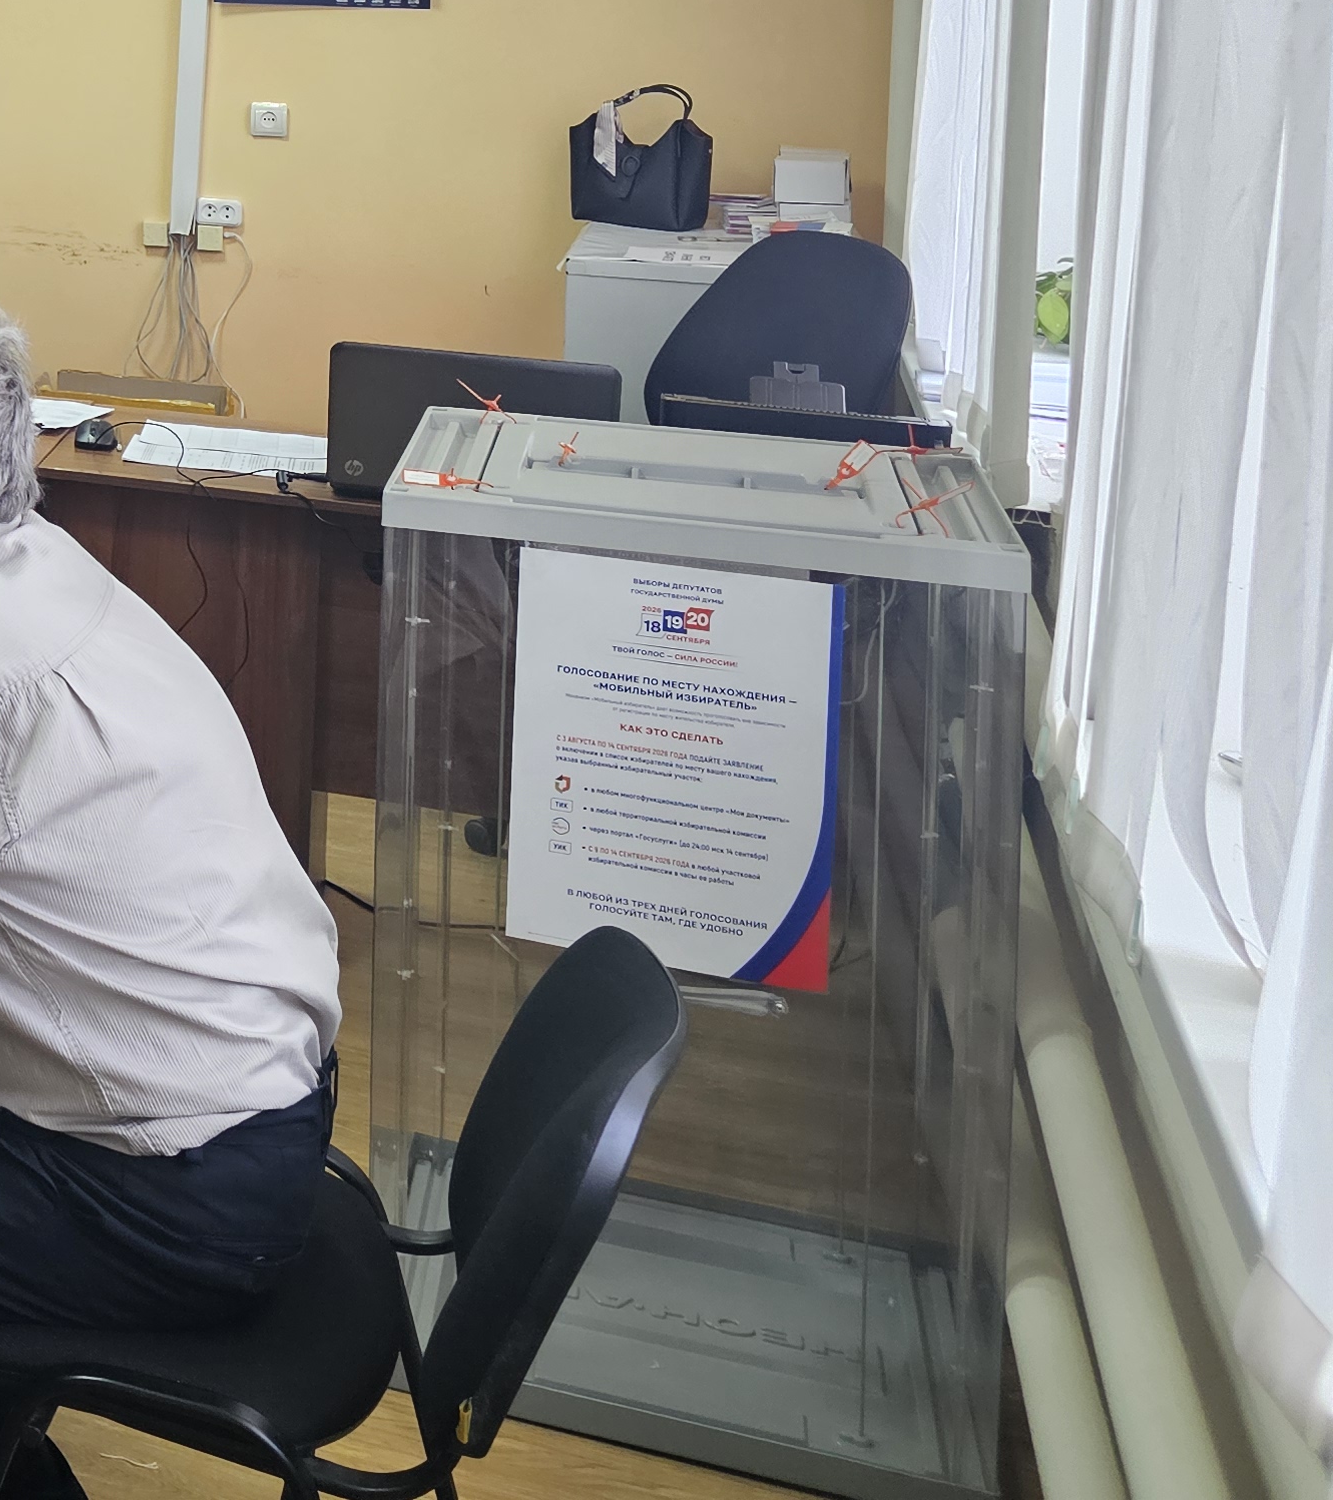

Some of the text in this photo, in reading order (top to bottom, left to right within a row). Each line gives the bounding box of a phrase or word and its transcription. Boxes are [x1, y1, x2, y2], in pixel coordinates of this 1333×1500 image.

[632, 577, 722, 594] ВЫБОРЫ ДЕПУТАТОВ
[643, 619, 661, 632] 18
[663, 613, 684, 630] 19
[685, 610, 710, 628] 20
[665, 633, 710, 645] СЕНТЯБРЯ
[611, 645, 634, 653] ТВОЙ
[636, 648, 664, 657] ГОЛОС
[674, 653, 698, 662] СИЛА
[699, 656, 736, 667] РОССИИ!
[557, 664, 639, 683] ГОЛОСОВАНИЕ
[642, 676, 658, 685] ПО
[661, 679, 699, 691] МЕСТУ
[702, 684, 785, 703] НАХОЖДЕНИЯ
[593, 682, 757, 710] «МОБИЛЬНЫЙ ИЗБИРАТЕЛЬ»
[619, 723, 723, 745] КАК ЭТО СДЕЛАТЬ
[575, 890, 612, 902] ЛЮБОЙ
[615, 897, 628, 905] ИЗ
[631, 899, 656, 911] ТРЕХ
[658, 904, 687, 916] ДНЕЙ
[689, 910, 767, 929] ГОЛОСОВАНИЯ
[589, 902, 743, 936] ГОЛОСУЙТЕ ТАМ, ГДЕ УДОБНО
